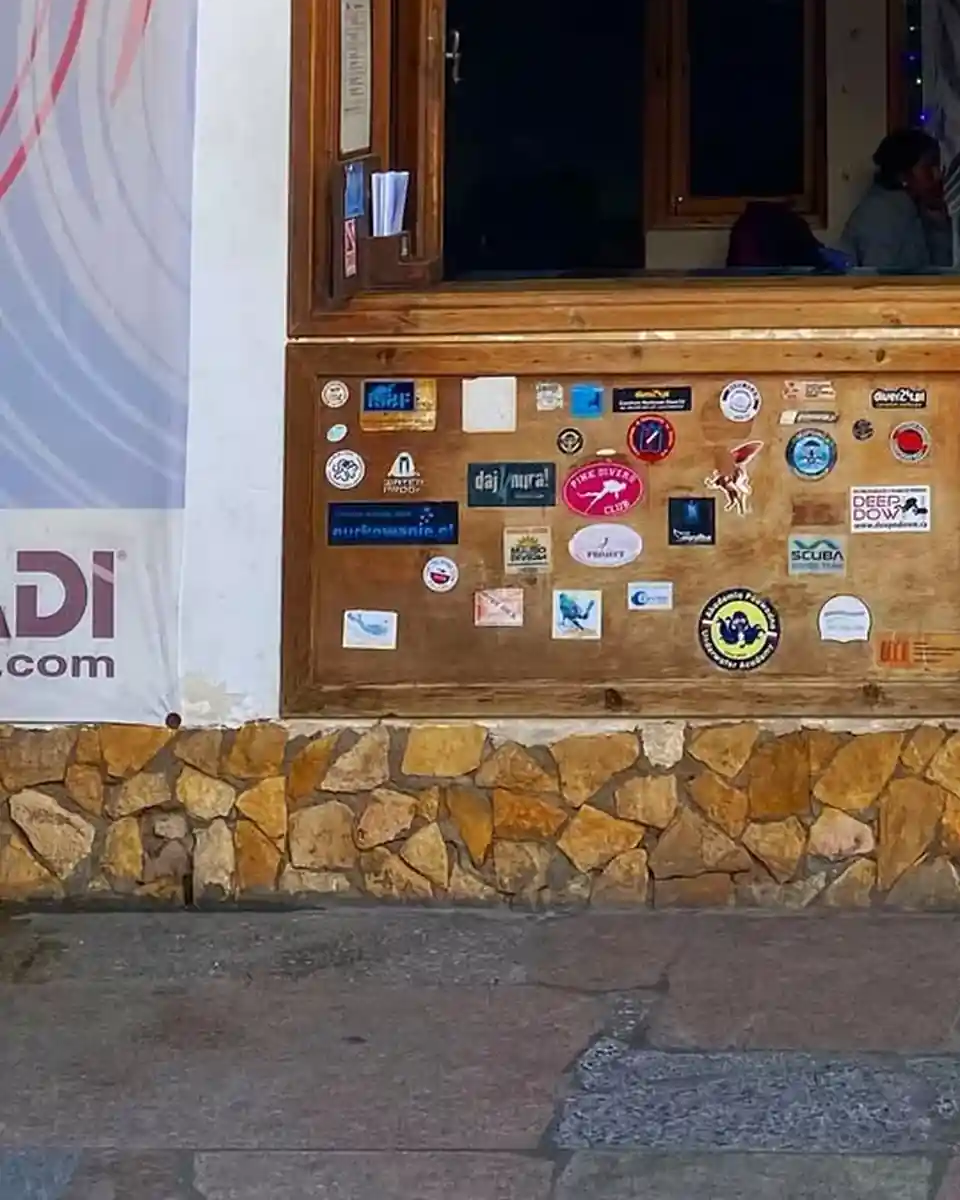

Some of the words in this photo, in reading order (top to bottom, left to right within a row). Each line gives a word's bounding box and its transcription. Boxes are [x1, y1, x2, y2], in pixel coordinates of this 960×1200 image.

[475, 470, 499, 493] daj
[570, 469, 597, 489] PINK
[598, 466, 637, 485] DIVERS
[604, 499, 631, 514] CLUB
[853, 495, 900, 507] DEEP
[791, 551, 844, 562] SCUBA
